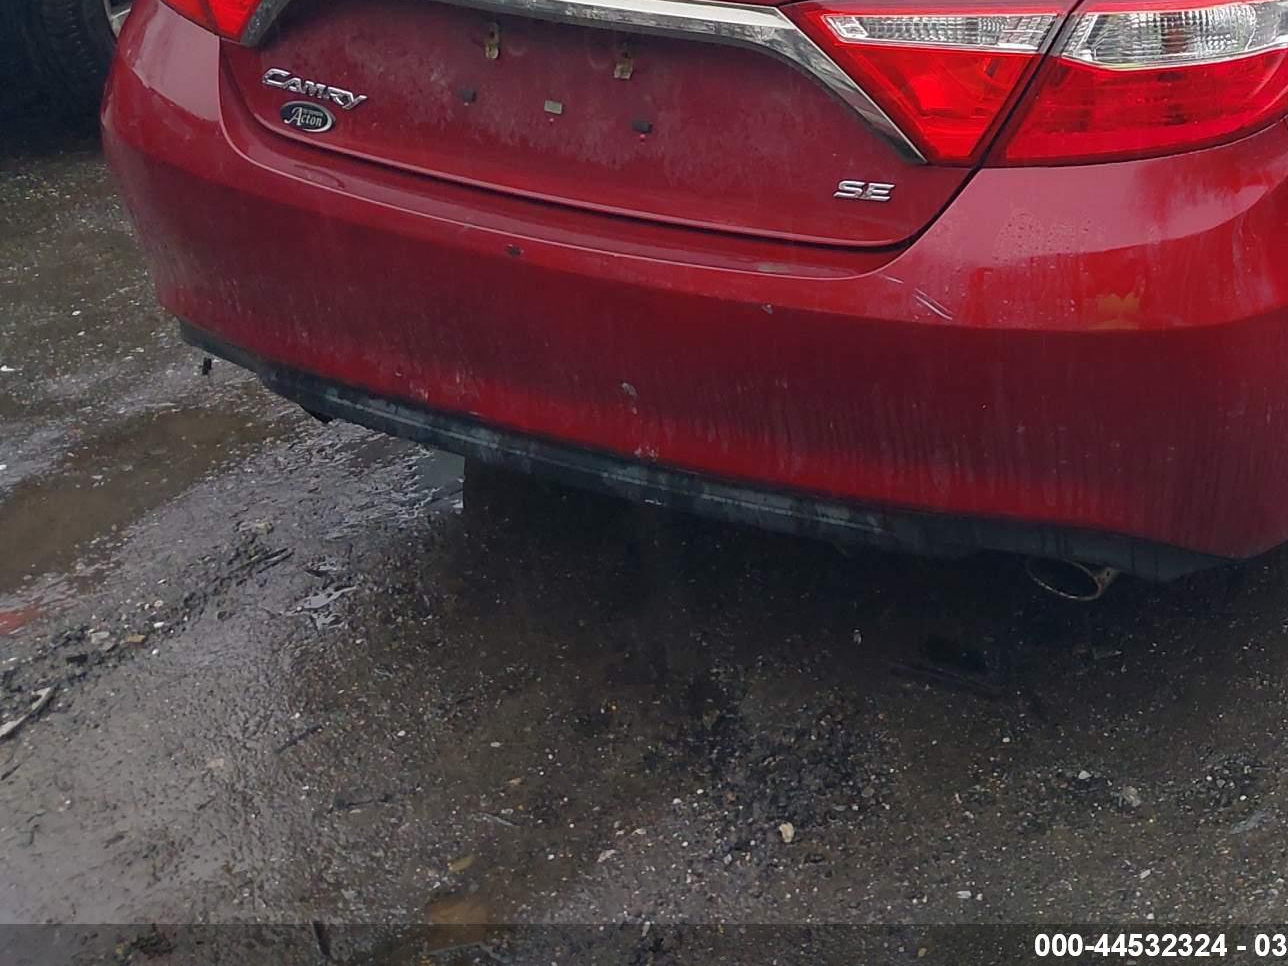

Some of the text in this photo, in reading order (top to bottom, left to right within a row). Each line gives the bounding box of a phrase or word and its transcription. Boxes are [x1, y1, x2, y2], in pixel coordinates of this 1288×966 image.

[262, 68, 368, 111] CAMRY
[283, 107, 323, 127] Acton
[833, 180, 896, 202] SE
